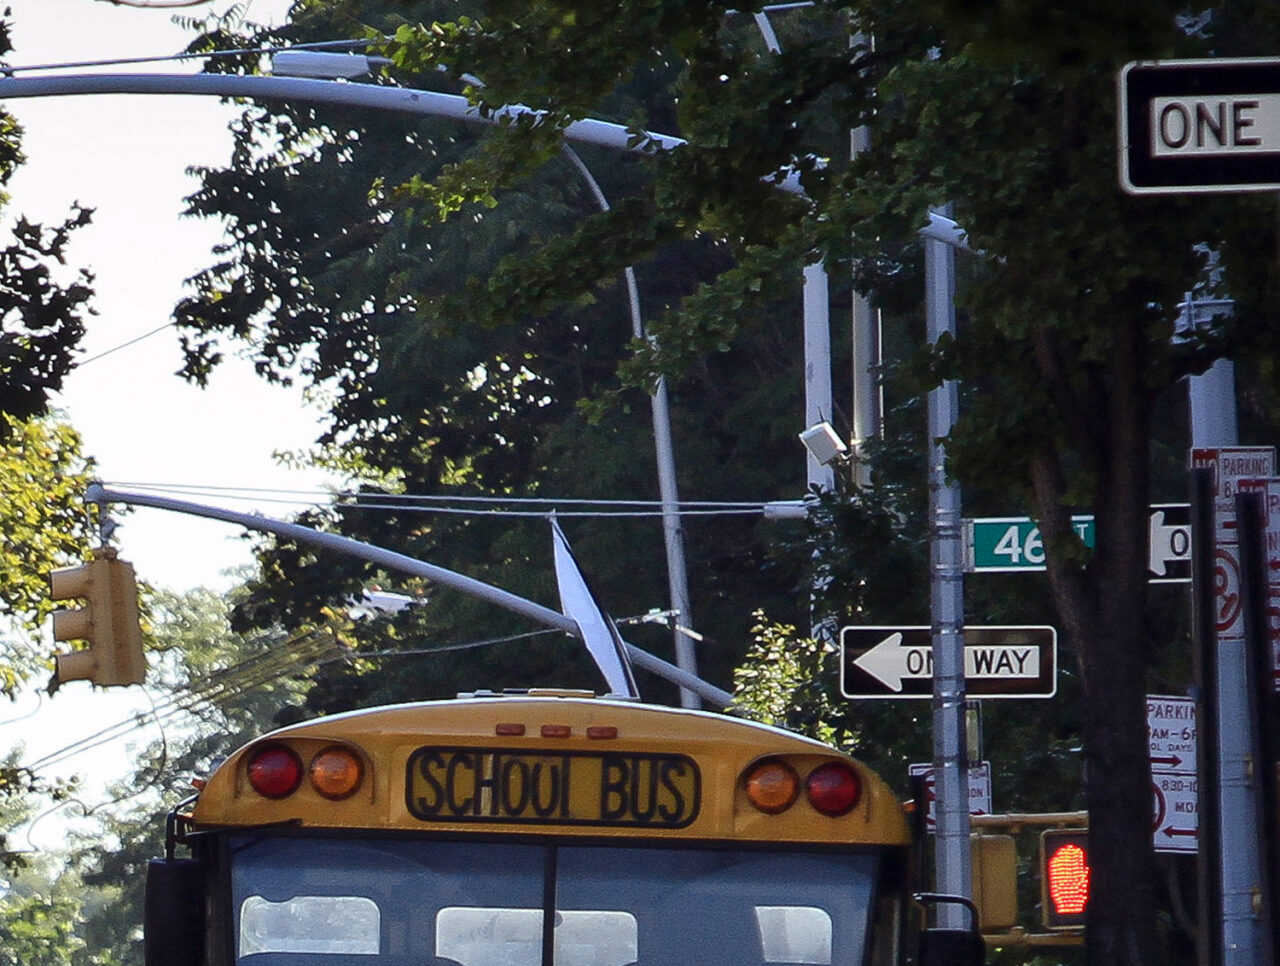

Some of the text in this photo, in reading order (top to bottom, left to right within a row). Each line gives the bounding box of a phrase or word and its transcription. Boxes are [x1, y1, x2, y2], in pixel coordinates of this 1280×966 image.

[1160, 100, 1262, 149] ONE
[1223, 458, 1269, 475] PARKING
[993, 525, 1047, 564] 46
[973, 649, 1031, 674] WAY
[600, 756, 687, 823] BUS
